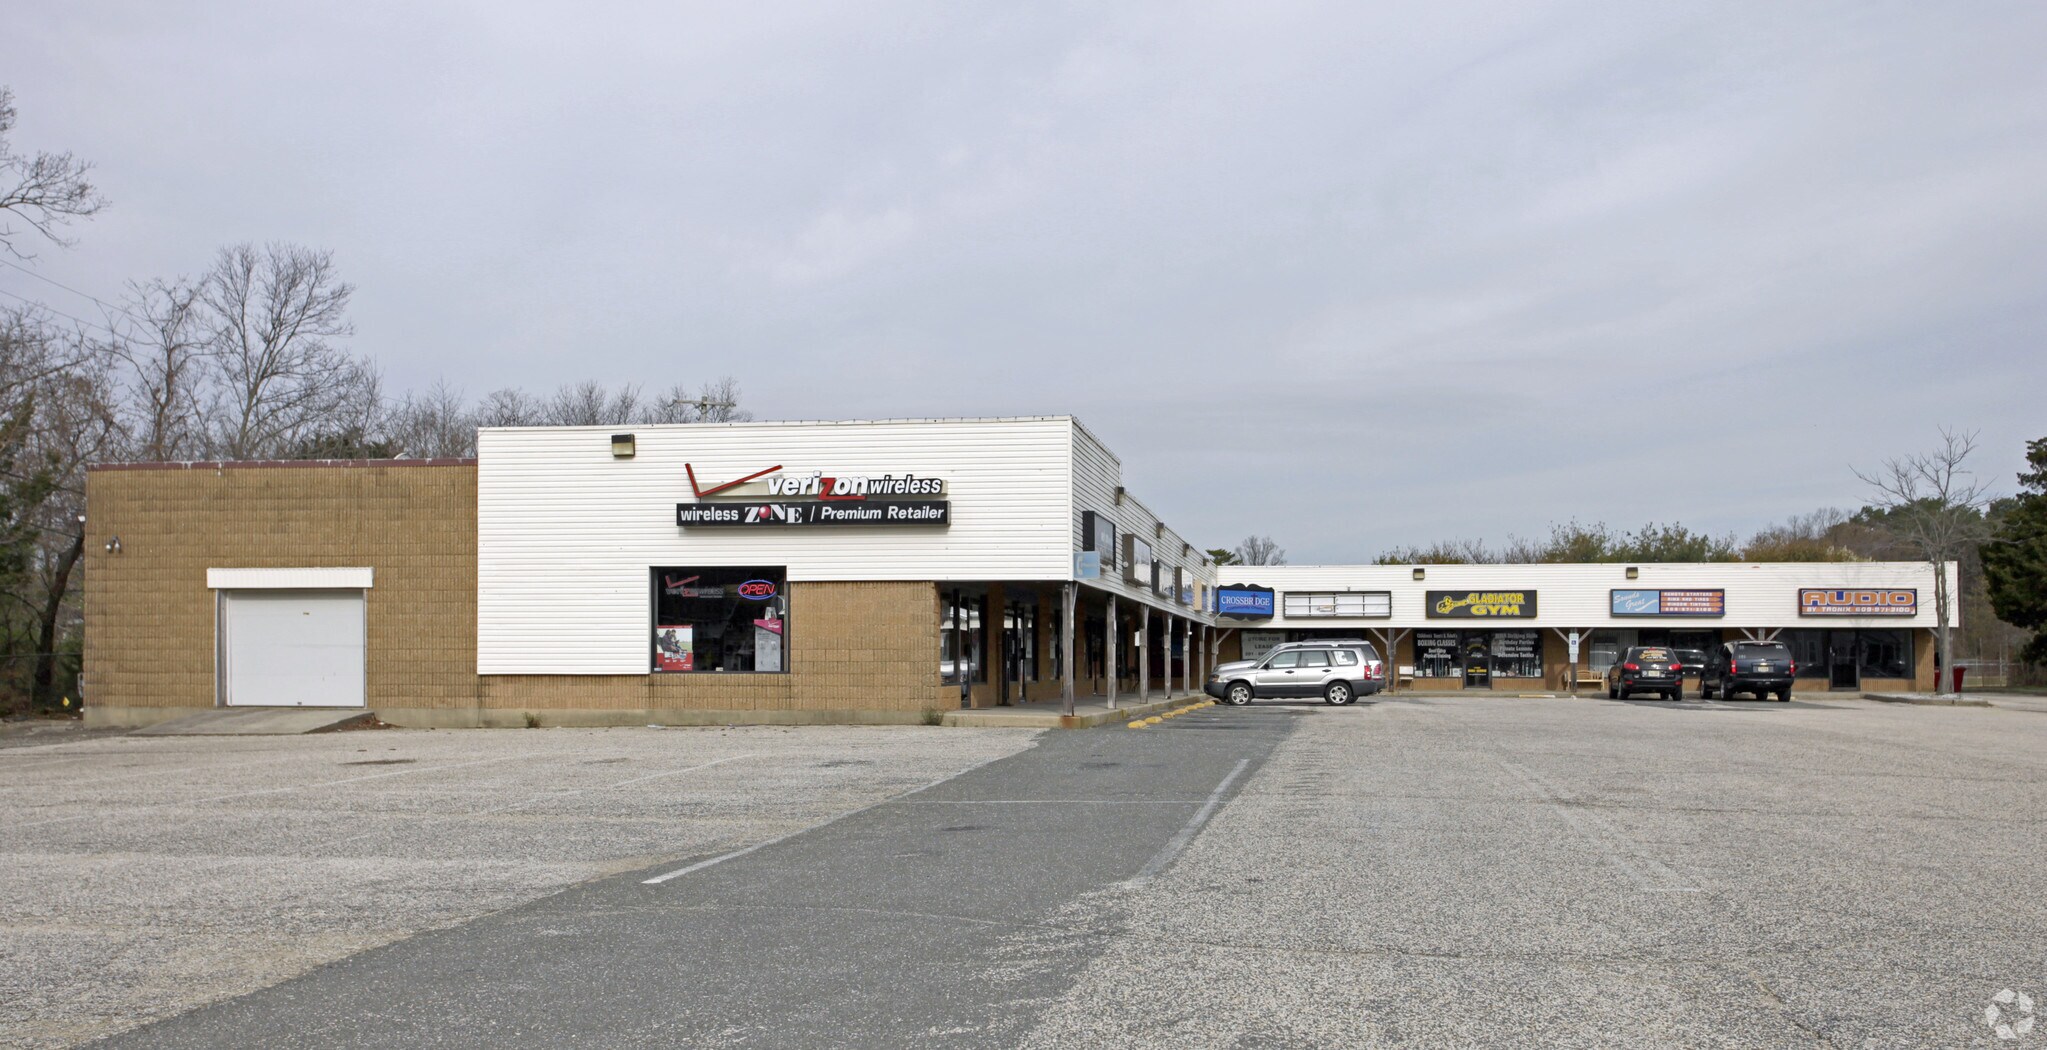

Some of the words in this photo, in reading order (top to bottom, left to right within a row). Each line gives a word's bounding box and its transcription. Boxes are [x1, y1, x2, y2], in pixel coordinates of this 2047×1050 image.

[767, 470, 869, 500] verizon
[869, 475, 941, 494] wireless
[680, 506, 739, 521] wireless
[744, 504, 802, 524] ZONE
[821, 506, 882, 520] Premium
[887, 505, 945, 519] Retailer
[740, 584, 775, 595] OPEN
[1467, 592, 1525, 605] GLADIATOR
[1613, 591, 1640, 604] Sounds
[1625, 598, 1645, 610] Great
[1803, 591, 1915, 606] AUDIO
[1470, 604, 1521, 615] GYM
